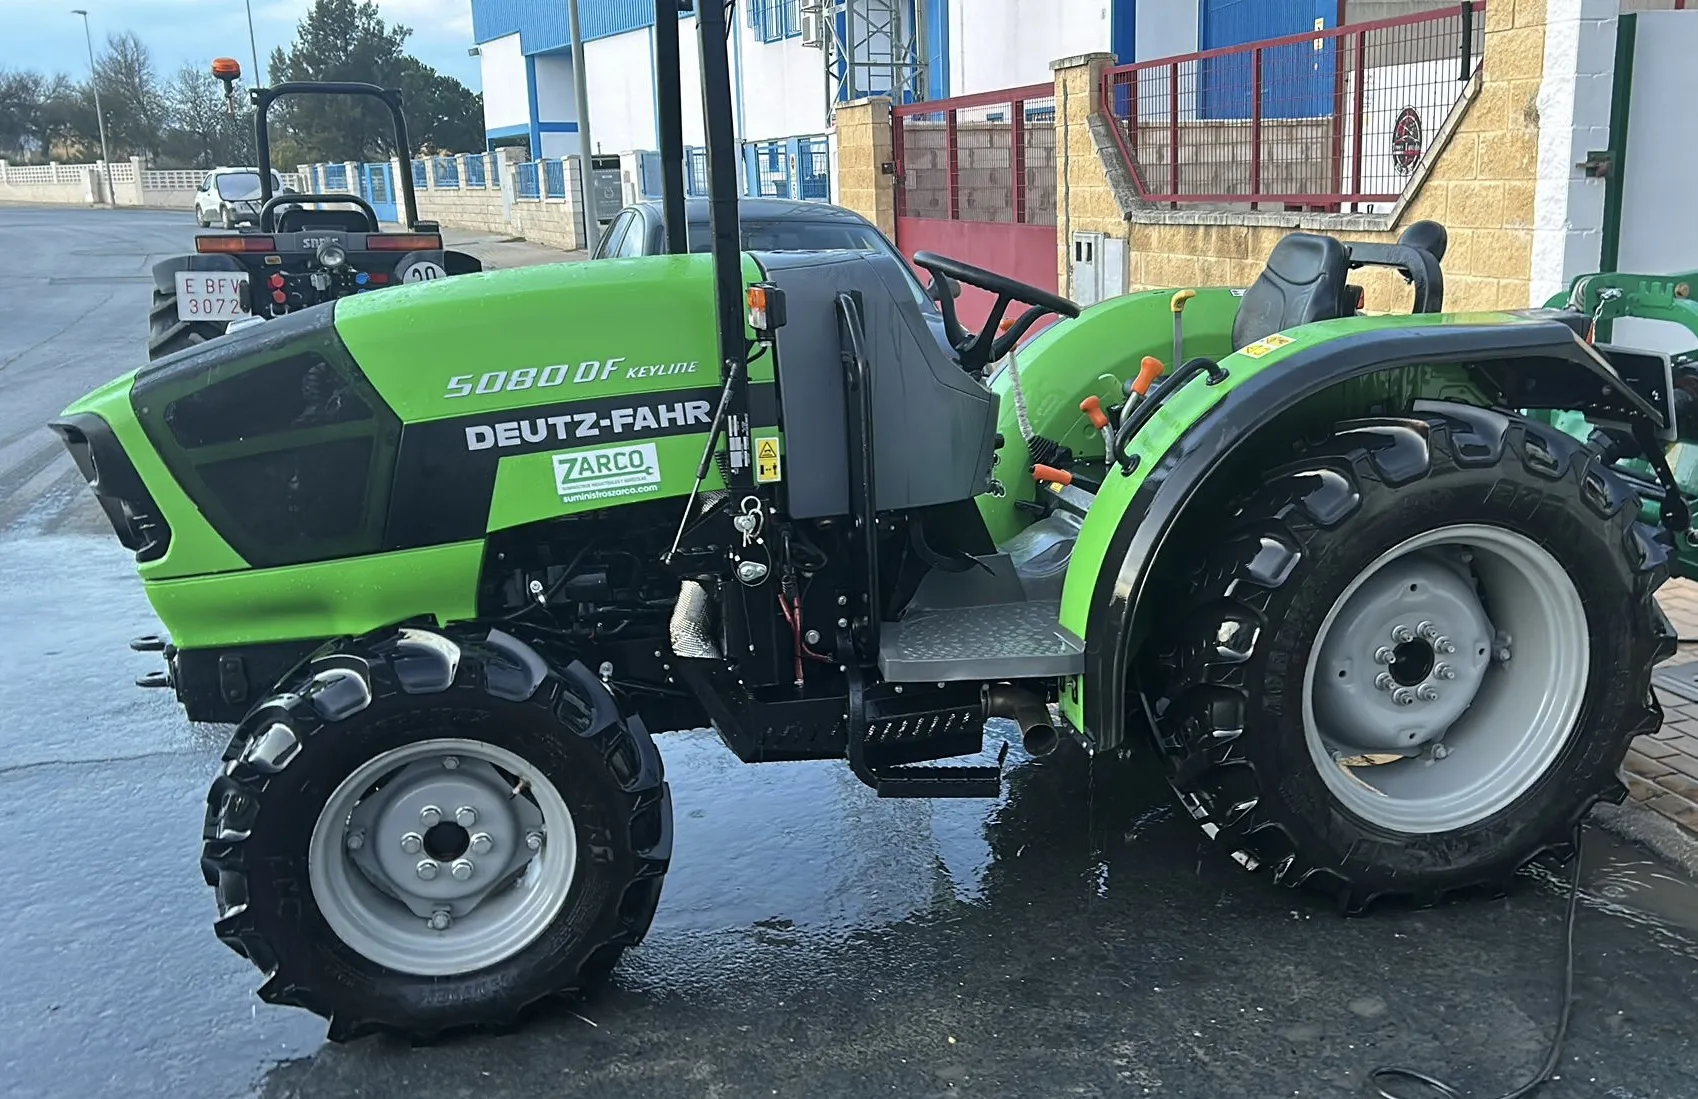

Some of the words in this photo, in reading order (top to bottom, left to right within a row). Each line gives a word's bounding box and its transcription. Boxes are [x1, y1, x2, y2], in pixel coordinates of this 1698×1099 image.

[185, 278, 195, 294] E
[205, 278, 240, 294] BFV
[189, 299, 240, 314] 3072
[444, 364, 569, 399] 5080
[573, 357, 626, 383] DF
[625, 361, 699, 379] KEYLINE
[465, 400, 713, 451] DEUTZ-FAHR
[558, 450, 644, 485] ZARCO
[563, 484, 658, 503] suministroszarco.com
